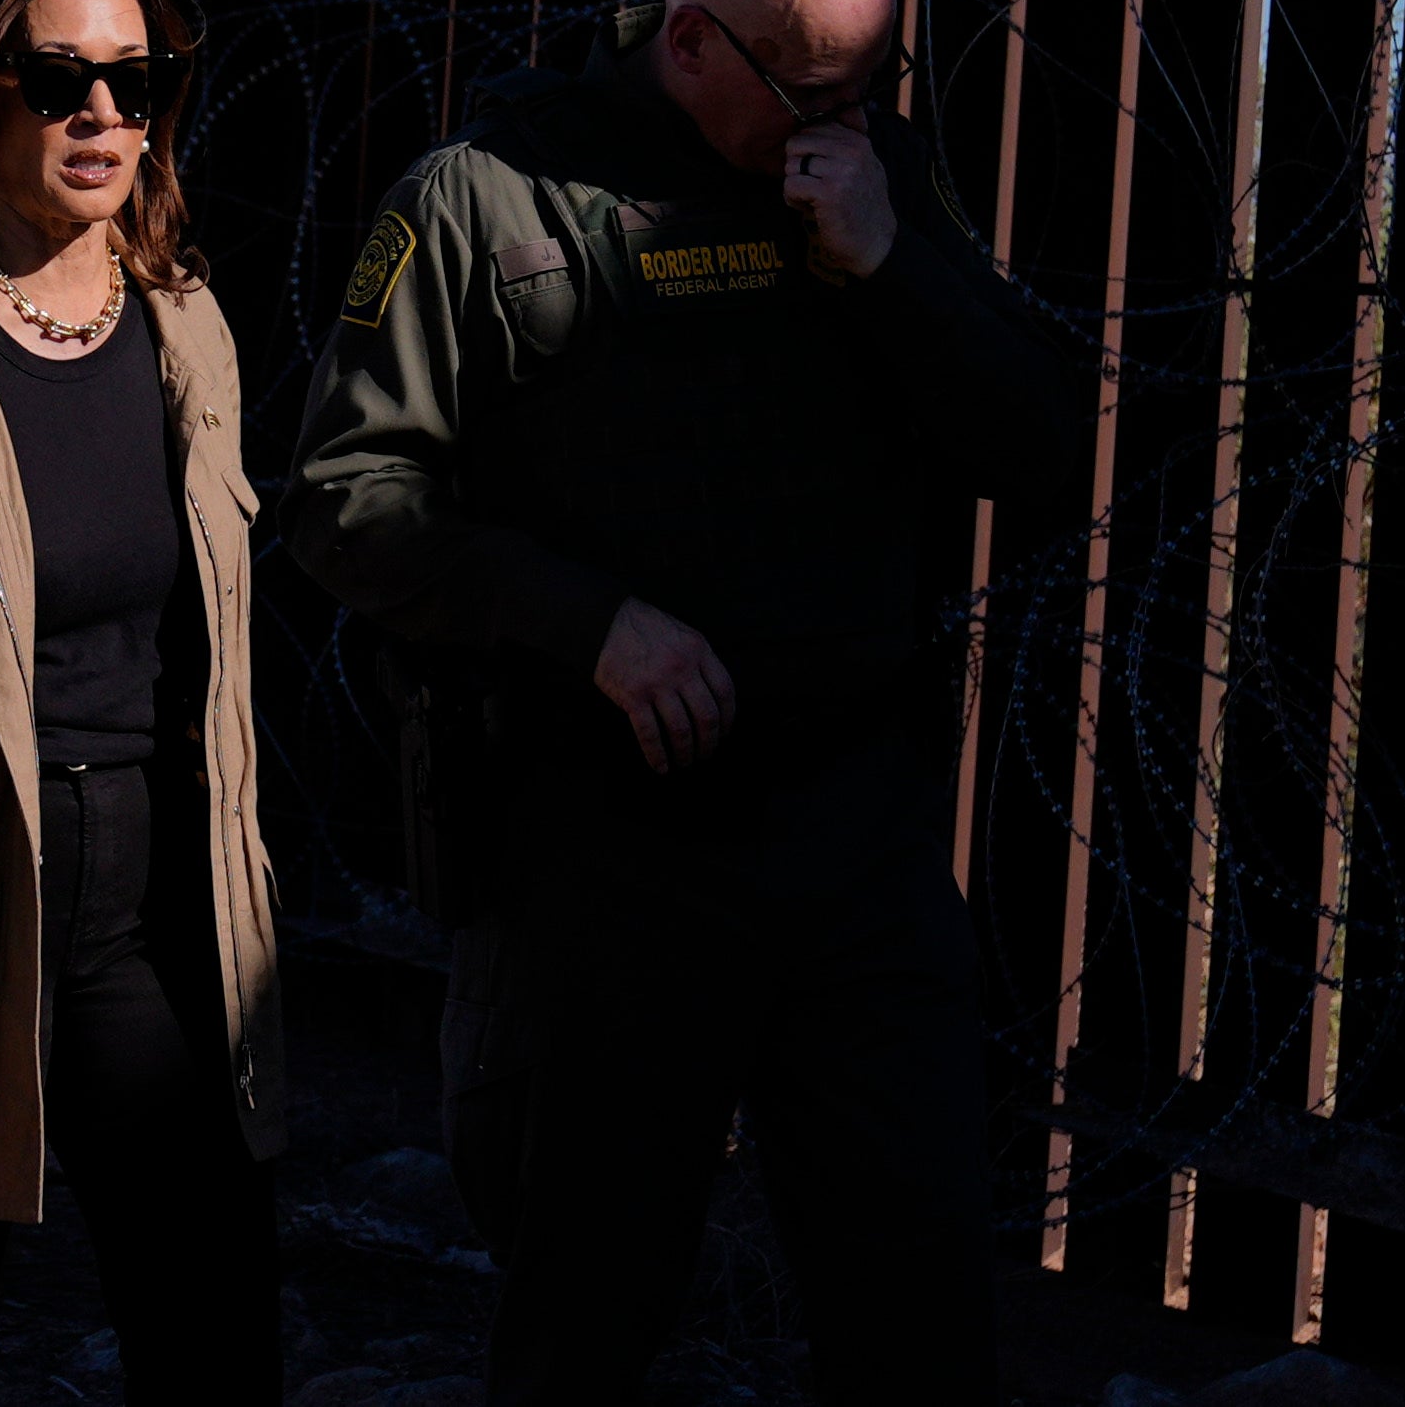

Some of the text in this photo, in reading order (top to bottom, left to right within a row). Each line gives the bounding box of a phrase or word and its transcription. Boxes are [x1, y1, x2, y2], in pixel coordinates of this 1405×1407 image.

[639, 240, 785, 281] BORDER PATROL
[655, 272, 778, 298] FEDERAL AGENT
